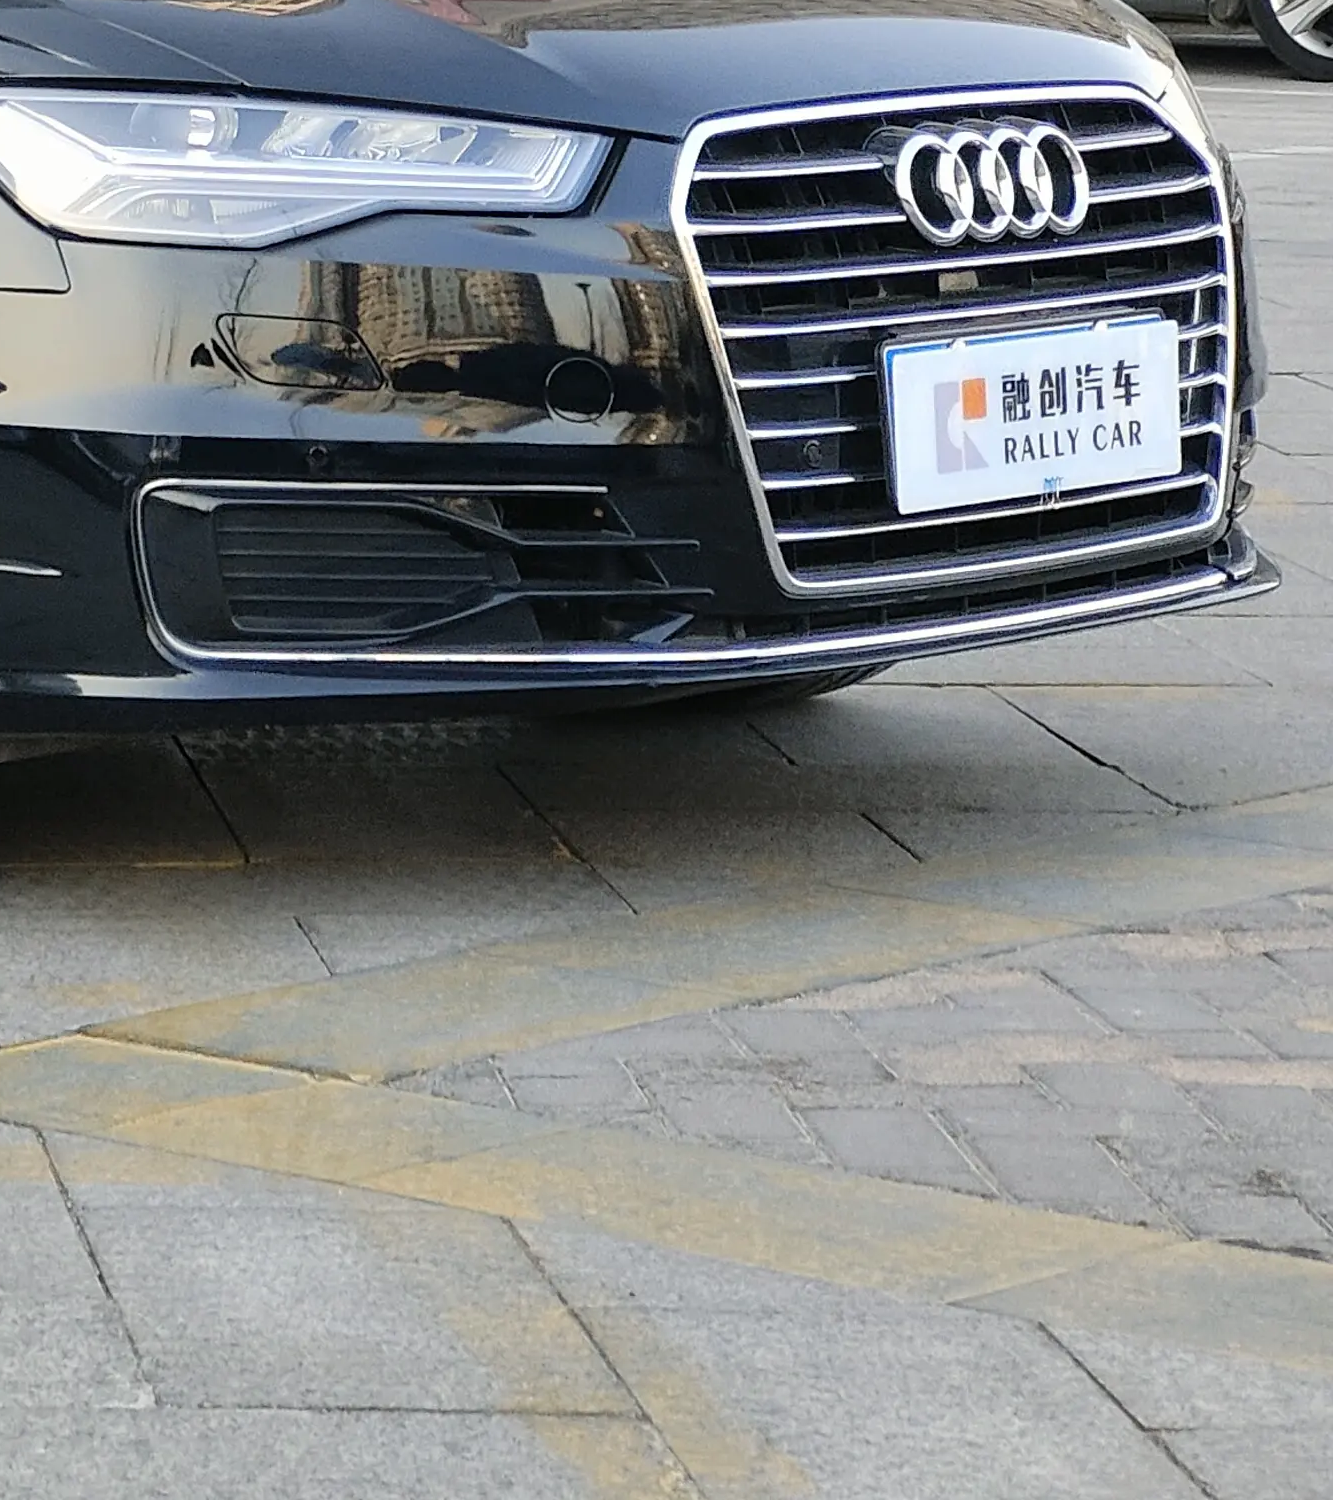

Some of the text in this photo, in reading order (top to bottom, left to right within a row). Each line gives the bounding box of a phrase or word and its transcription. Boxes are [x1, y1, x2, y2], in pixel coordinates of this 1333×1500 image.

[1000, 359, 1142, 423] 融创汽车
[1004, 420, 1143, 464] RALLY CAR
